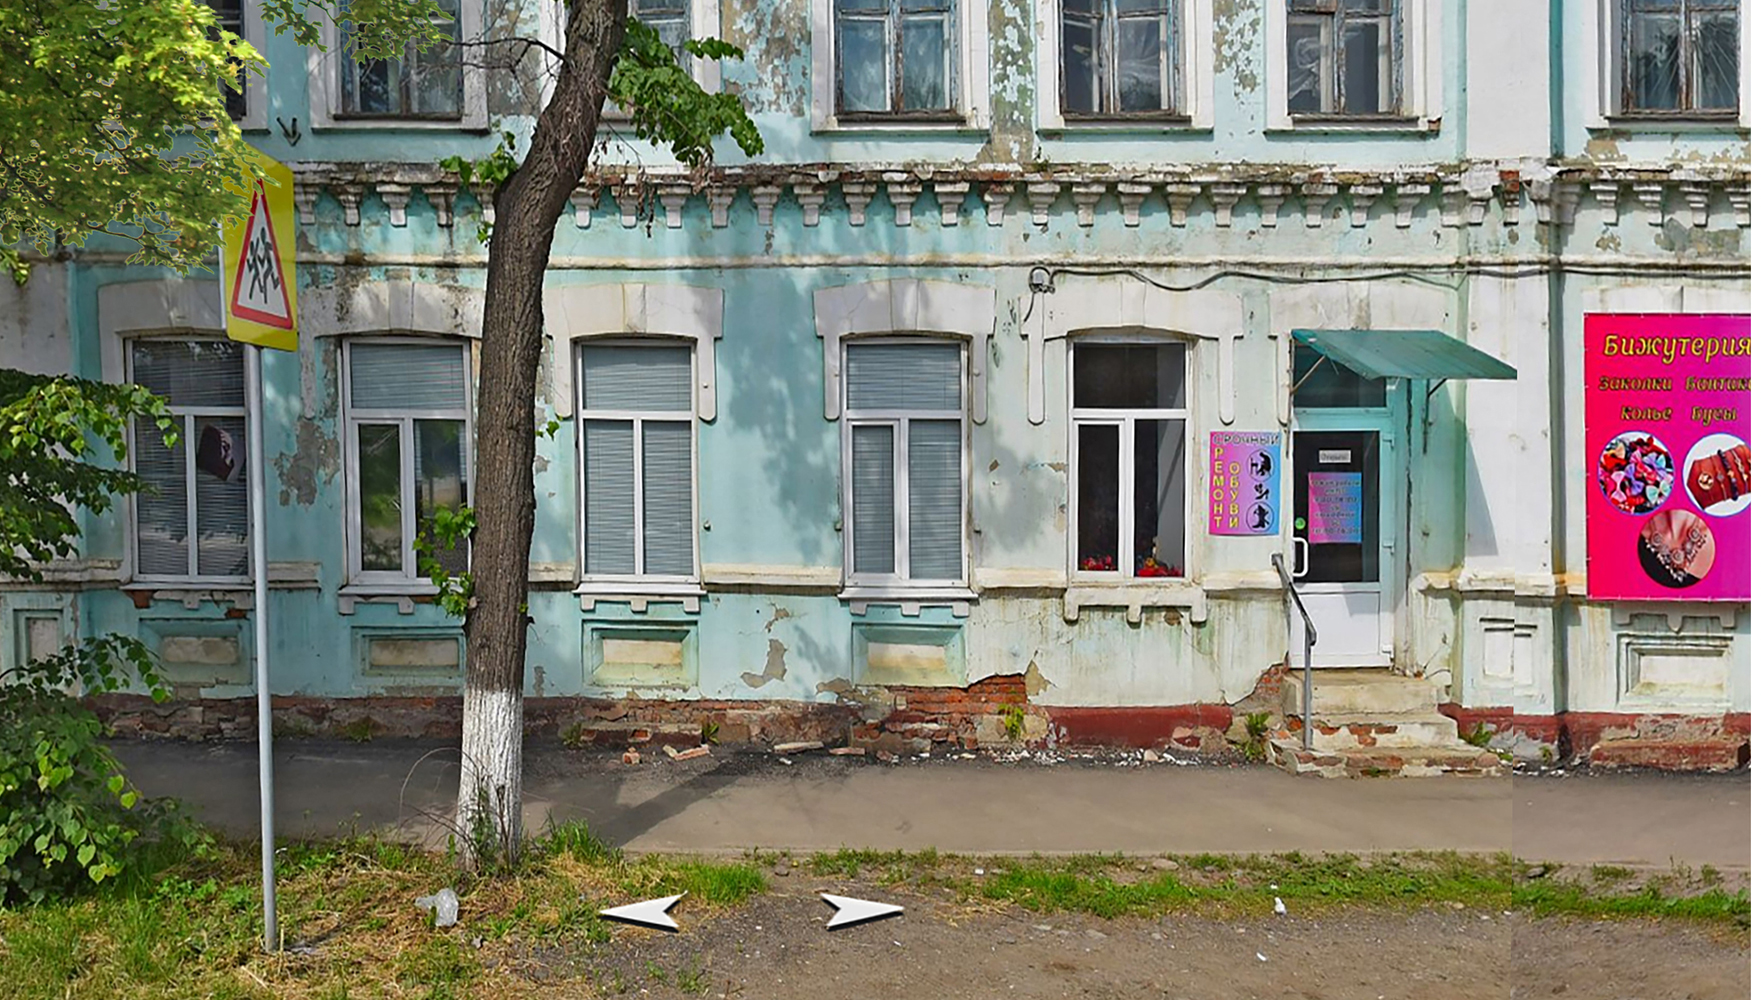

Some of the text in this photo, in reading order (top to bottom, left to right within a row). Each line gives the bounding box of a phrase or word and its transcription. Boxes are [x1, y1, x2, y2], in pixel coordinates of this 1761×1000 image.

[1604, 334, 1751, 364] Бижутерия
[1599, 376, 1672, 391] Заколки
[1621, 405, 1737, 426] Колье Бусы
[1213, 448, 1224, 528] РЕМОНТ
[1229, 462, 1240, 528] ОБУВИ
